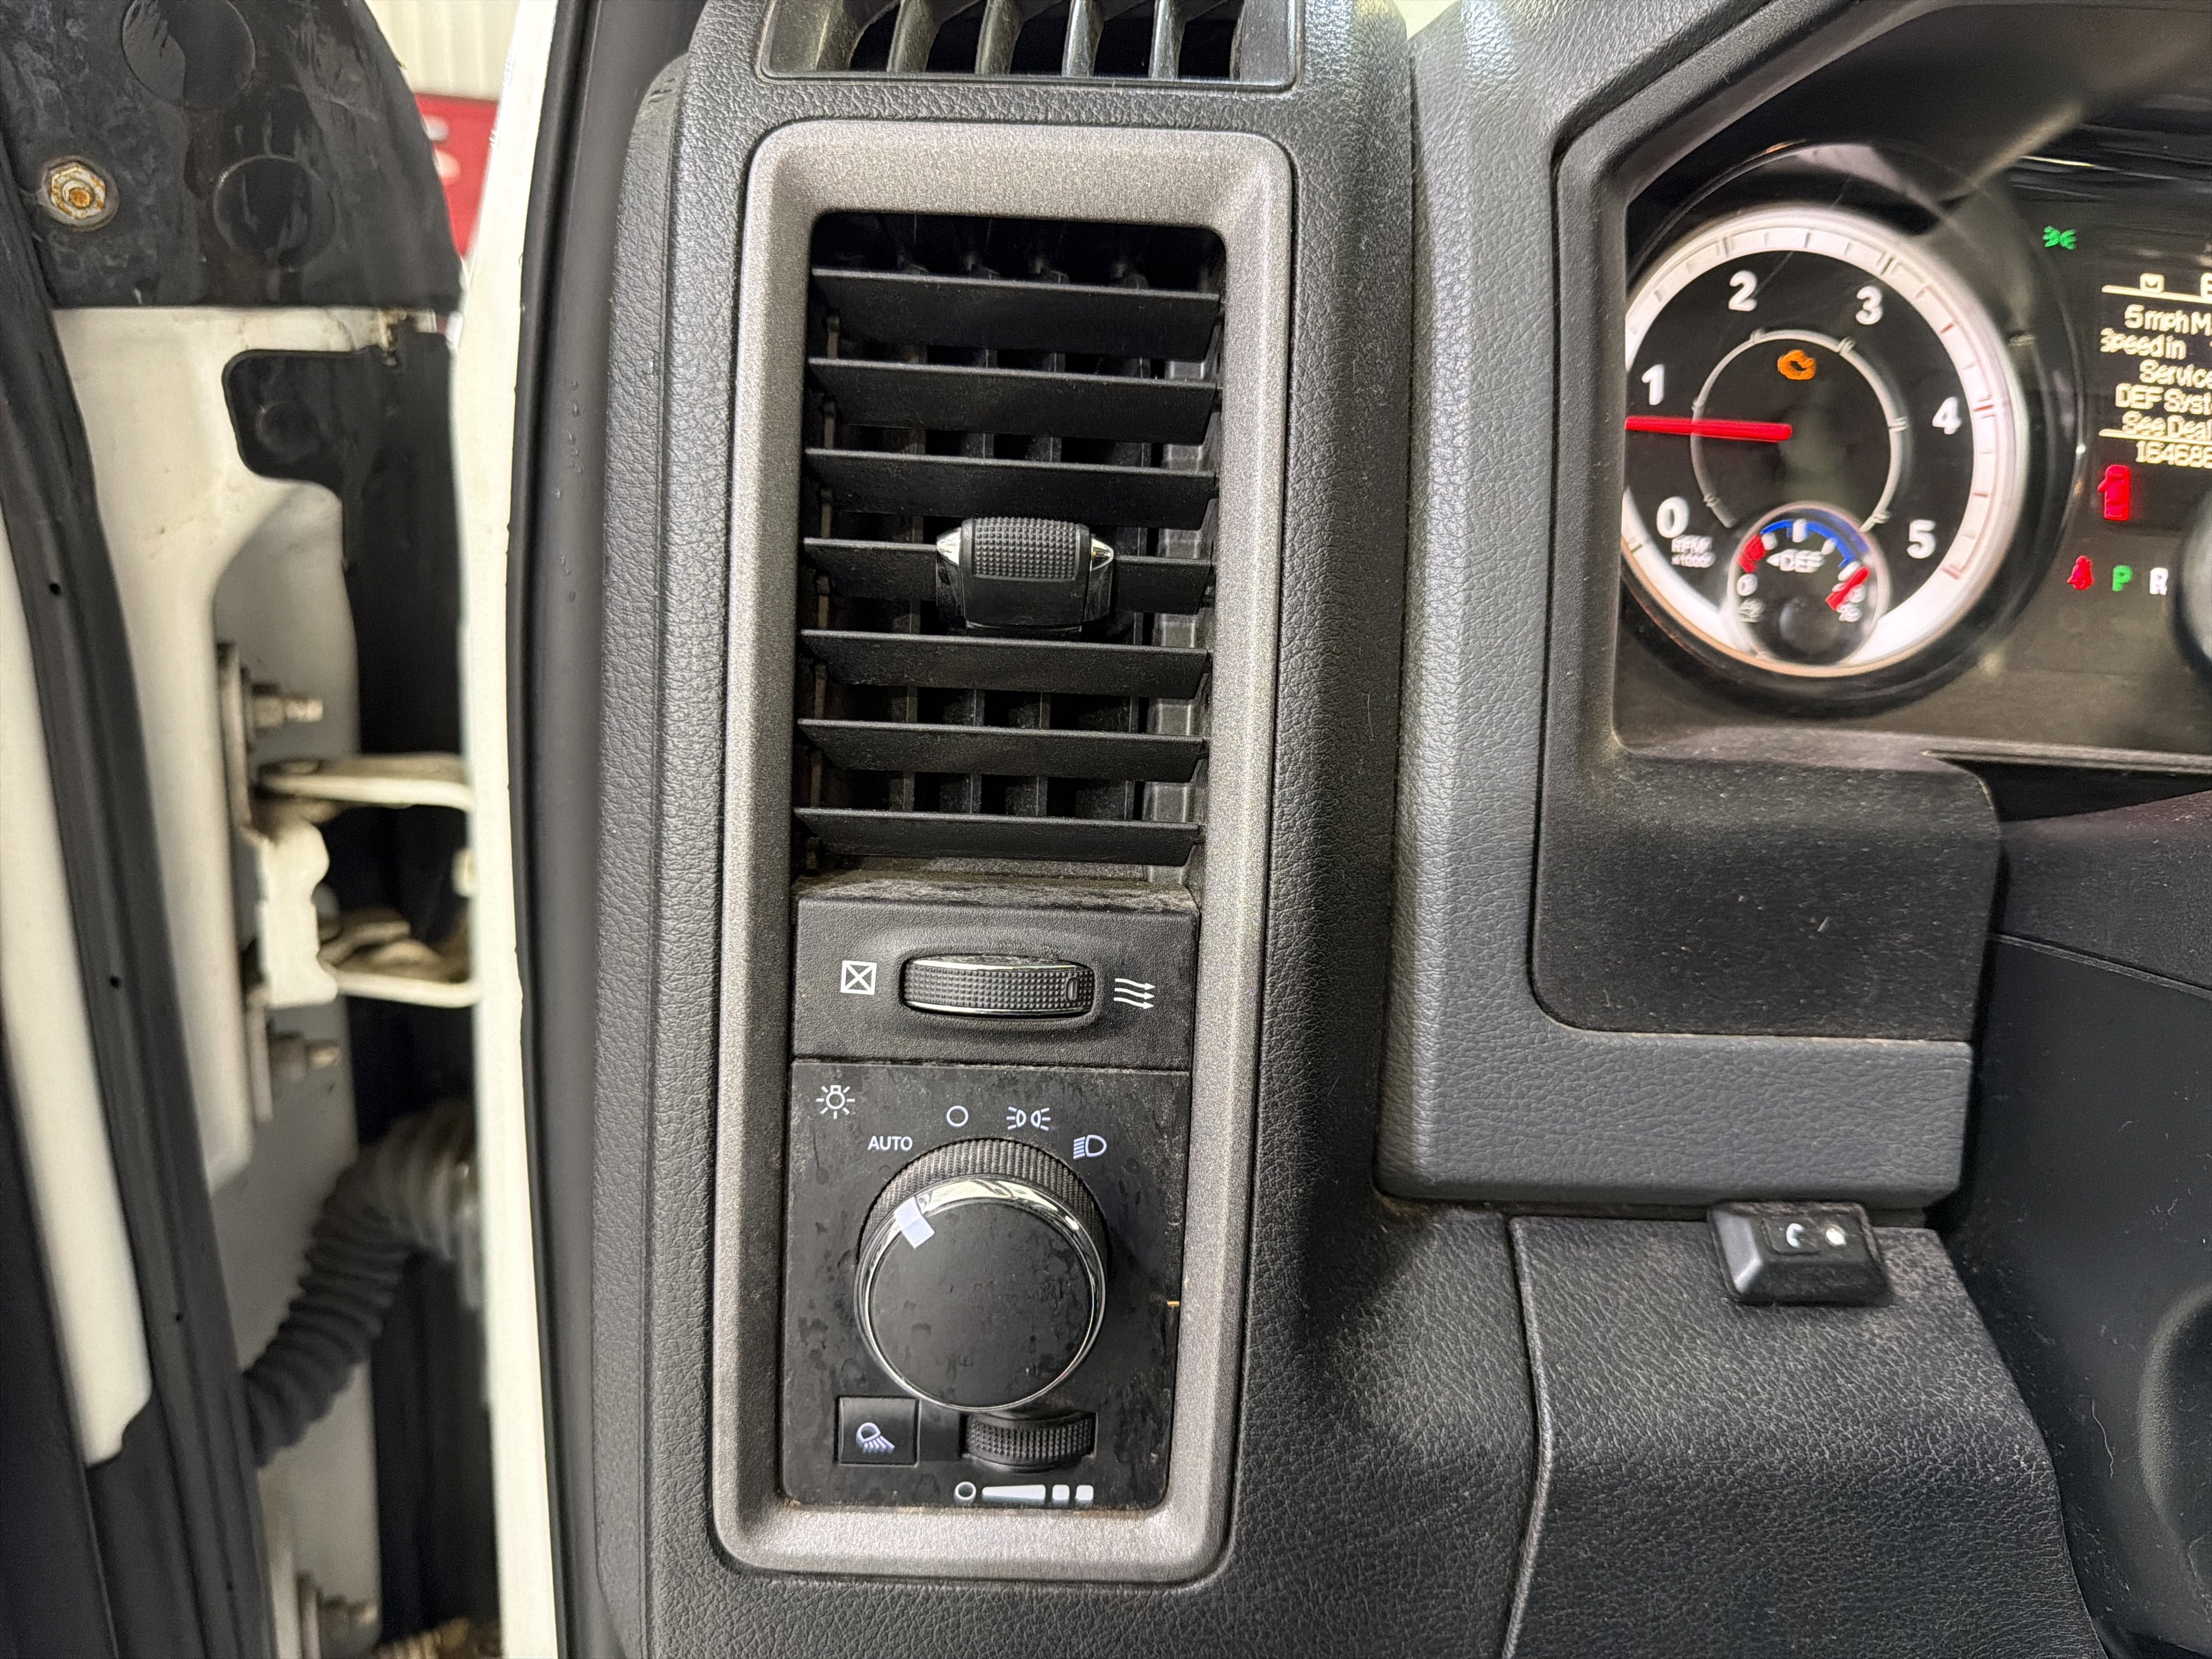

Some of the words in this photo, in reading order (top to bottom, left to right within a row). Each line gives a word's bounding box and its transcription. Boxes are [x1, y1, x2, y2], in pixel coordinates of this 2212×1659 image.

[1728, 271, 1757, 312] 2
[1856, 286, 1883, 325] 3
[2101, 328, 2165, 358] Speed
[2165, 335, 2187, 360] in
[1641, 364, 1665, 405] 1
[2115, 382, 2164, 410] DEF
[1933, 397, 1962, 435] 4
[2122, 410, 2166, 437] See
[1656, 496, 1689, 538] 0
[1907, 520, 1936, 559] 5
[2112, 565, 2132, 591] P
[2149, 567, 2169, 595] R
[867, 1135, 913, 1152] AUTO
